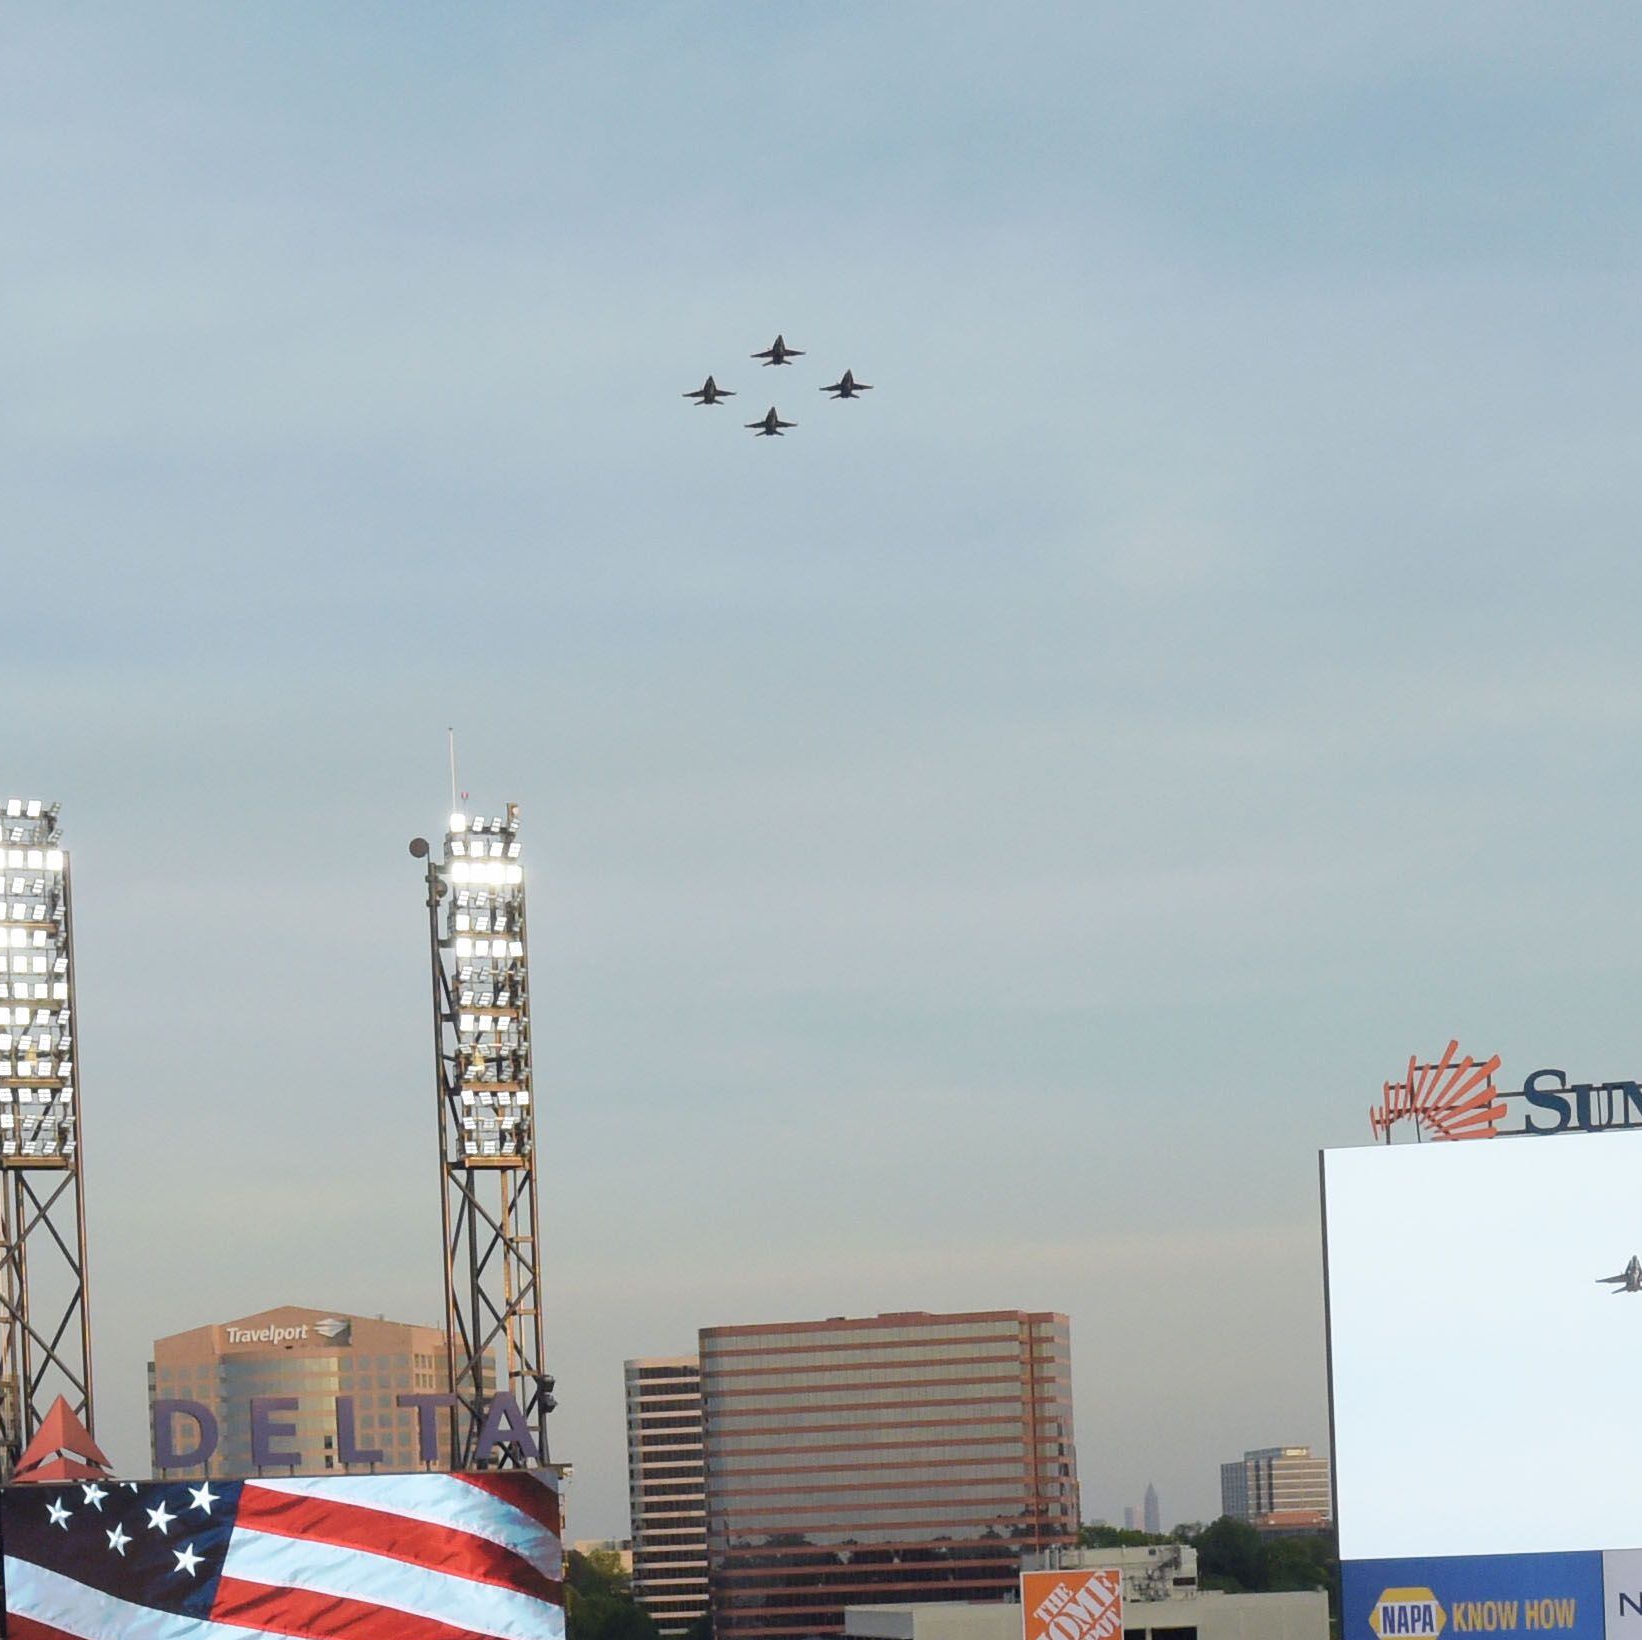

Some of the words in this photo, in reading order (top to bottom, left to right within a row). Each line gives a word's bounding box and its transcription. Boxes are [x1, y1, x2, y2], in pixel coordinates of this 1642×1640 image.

[226, 1320, 307, 1345] Travelport
[155, 1391, 539, 1468] DELTA
[1033, 1582, 1074, 1624] THE
[1452, 1601, 1518, 1632] KNOW
[1525, 1600, 1575, 1630] HOW
[1382, 1605, 1434, 1635] NAPA
